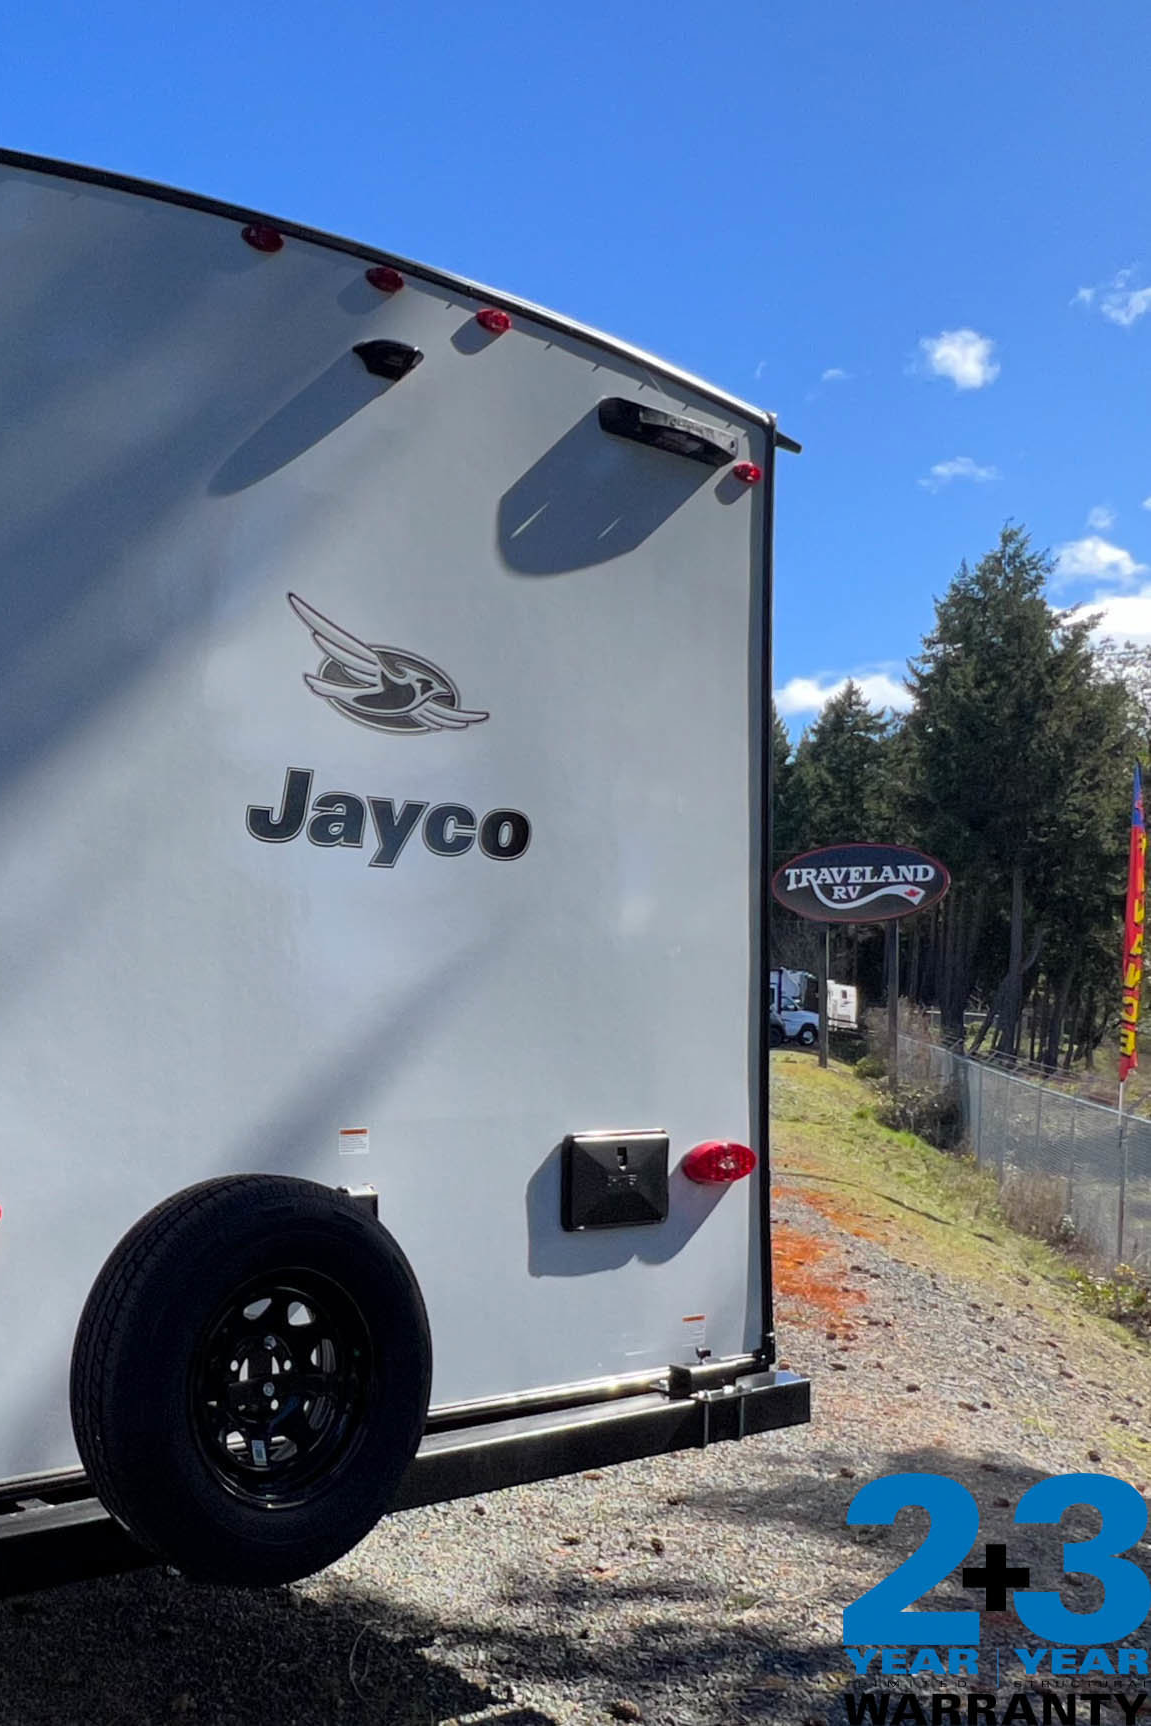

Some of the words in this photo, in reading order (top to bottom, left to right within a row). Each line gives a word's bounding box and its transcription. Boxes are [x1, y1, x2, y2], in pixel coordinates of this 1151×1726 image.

[246, 767, 532, 868] Jayco
[785, 864, 936, 891] TRAVELAND
[832, 885, 862, 900] RV
